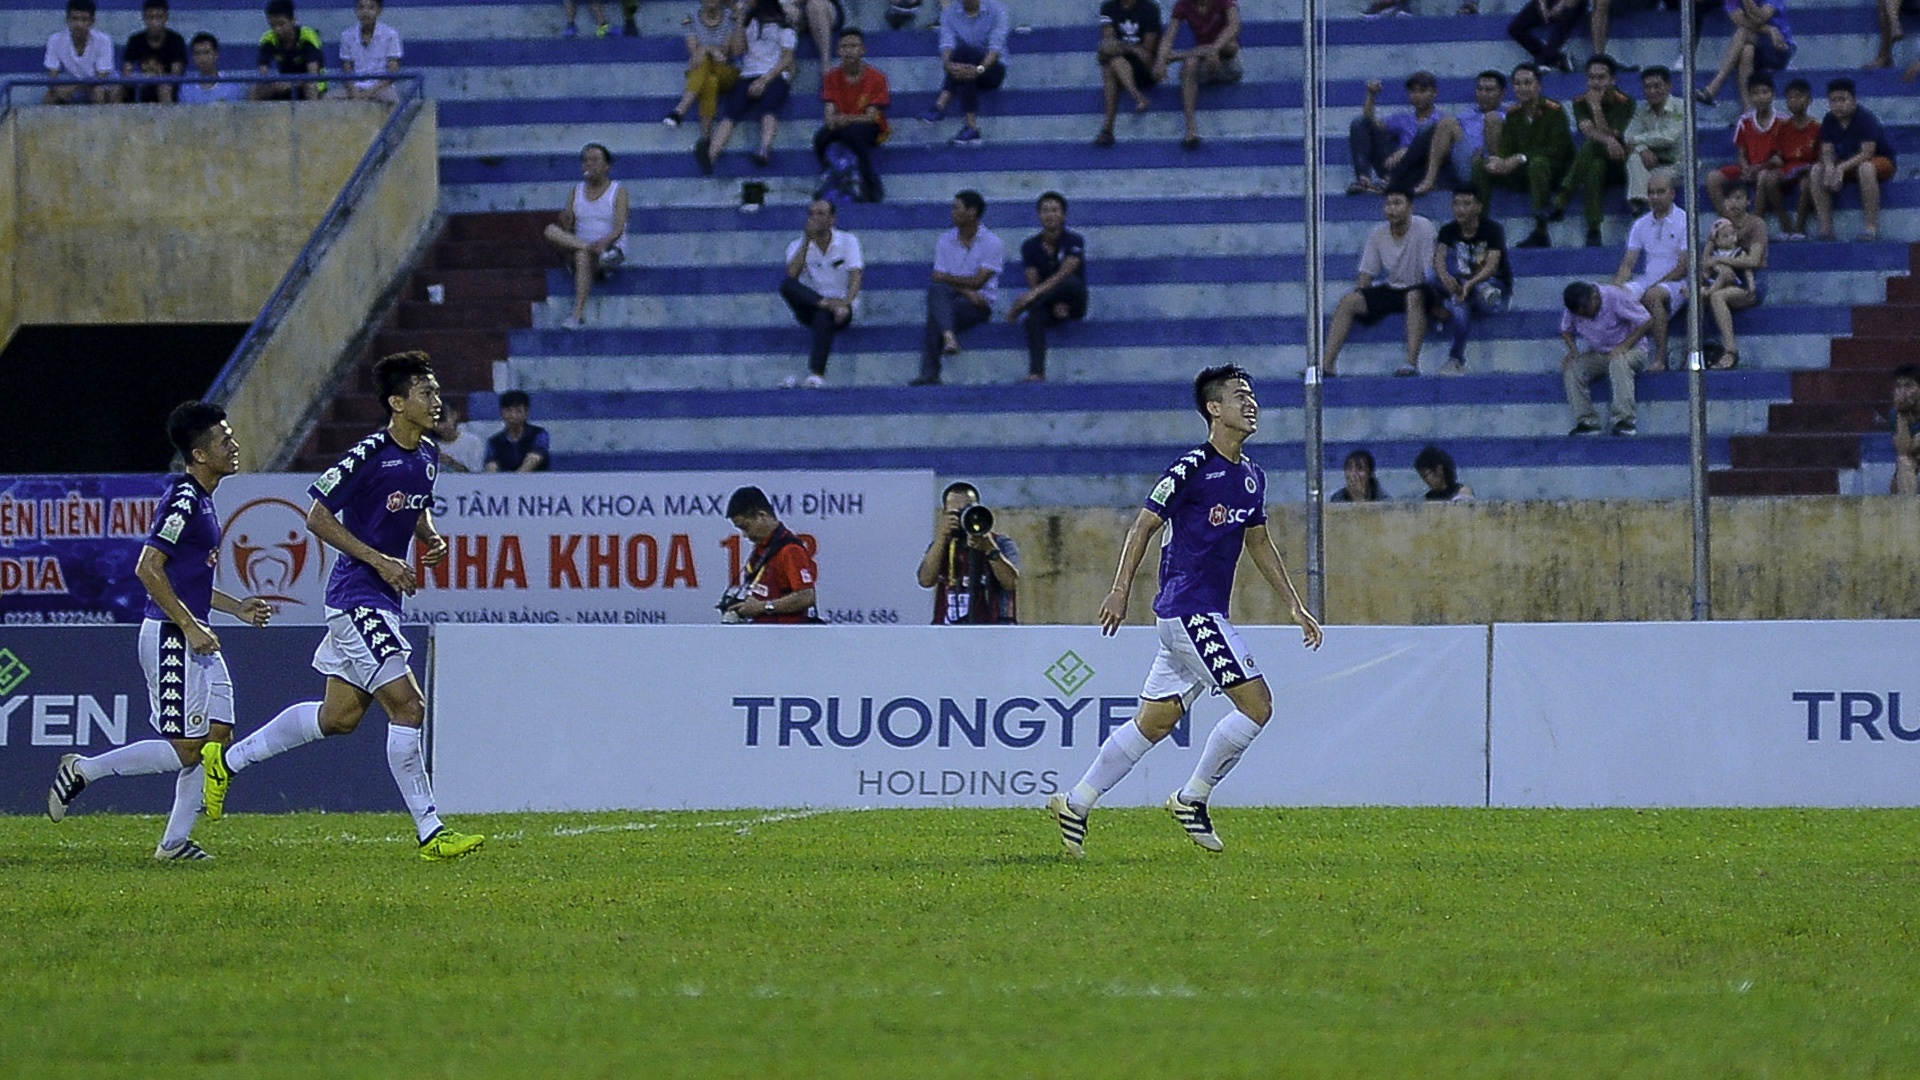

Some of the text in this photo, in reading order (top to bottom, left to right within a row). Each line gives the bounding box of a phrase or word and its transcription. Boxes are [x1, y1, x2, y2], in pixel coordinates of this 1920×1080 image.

[43, 492, 103, 538] LIÊN
[457, 491, 508, 517] TÂM
[519, 496, 572, 516] NHA
[581, 495, 655, 517] KHOA
[664, 495, 722, 516] MAX
[801, 488, 863, 520] ĐỊNH
[1, 559, 65, 592] DIA
[549, 532, 699, 590] KHOA
[576, 611, 618, 624] NAM
[0, 694, 128, 746] YEN
[1791, 691, 1920, 741] TRU
[859, 770, 1058, 795] HOLDINGS
